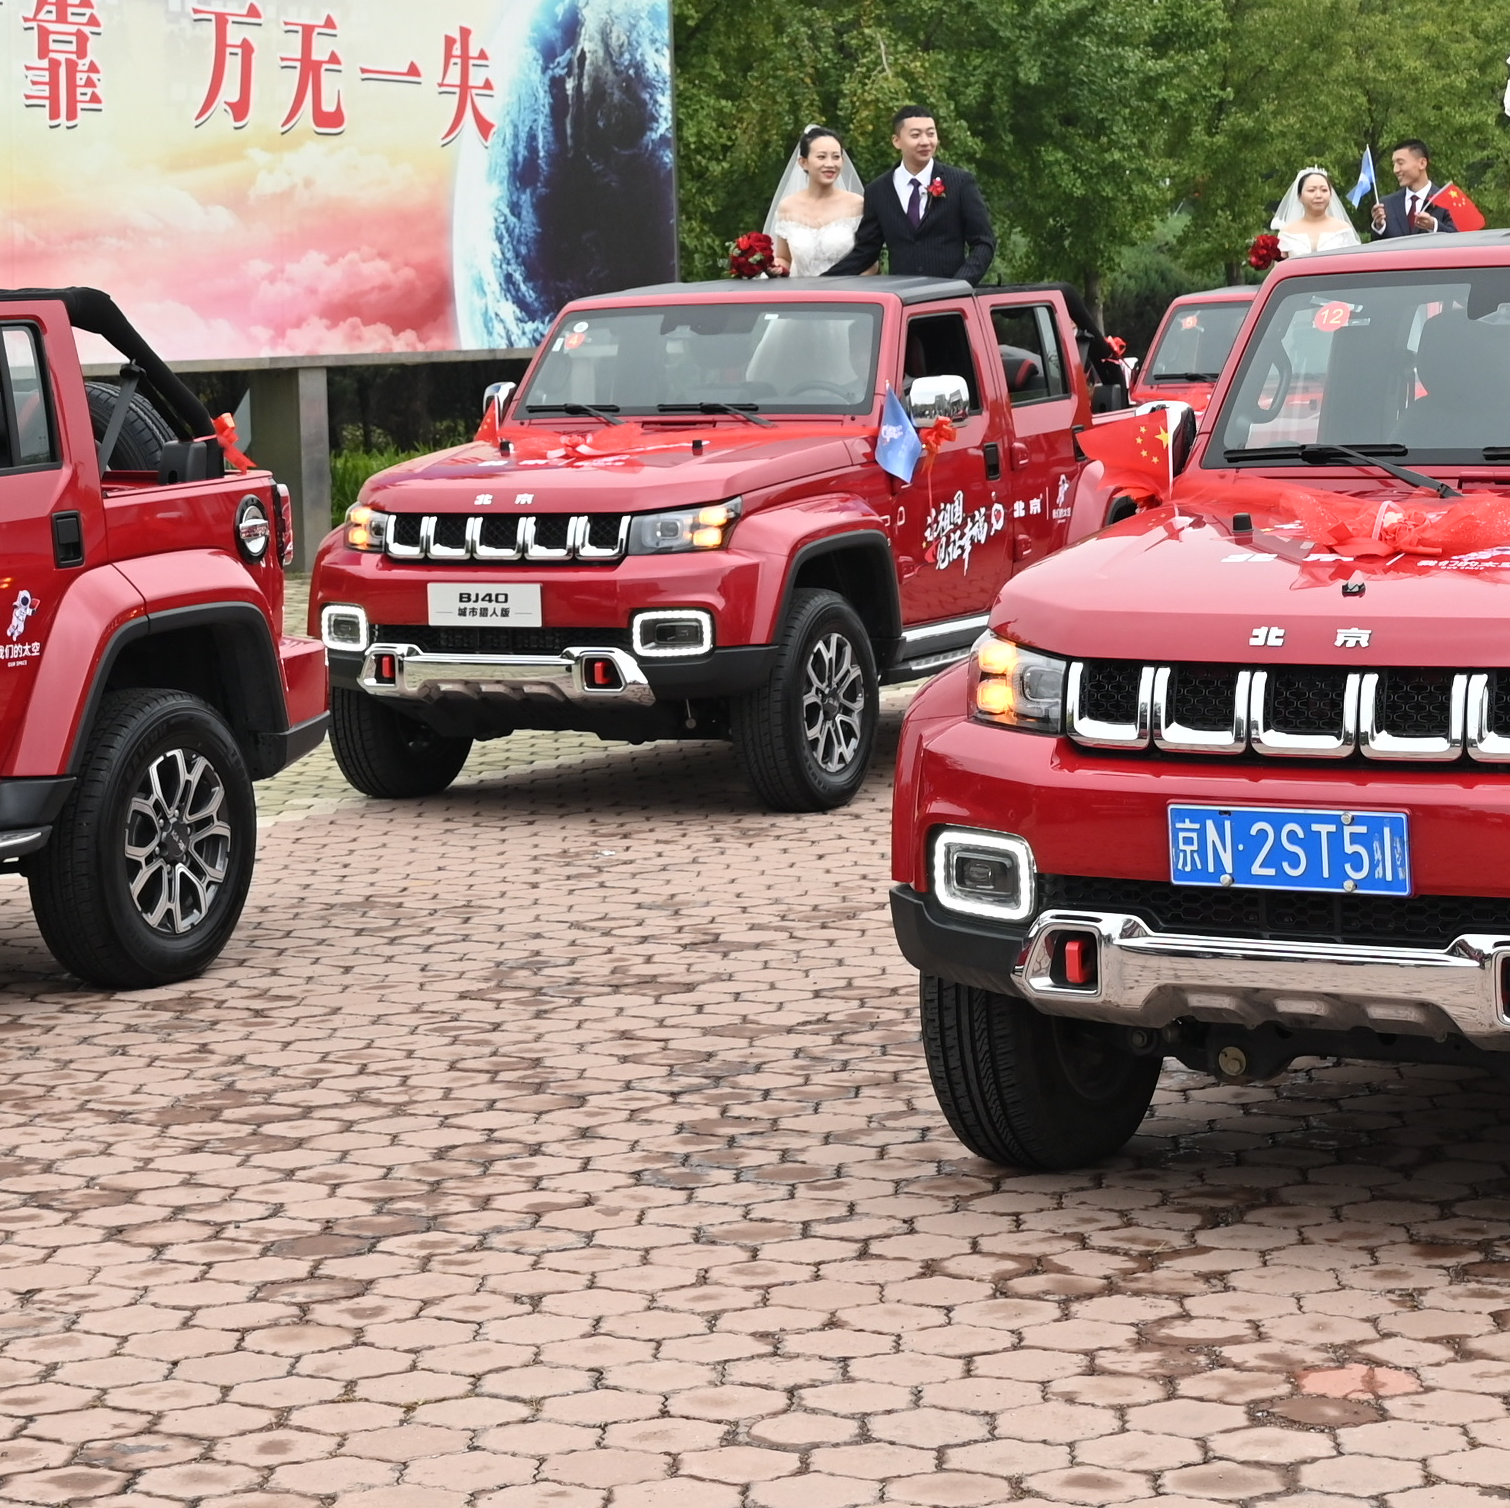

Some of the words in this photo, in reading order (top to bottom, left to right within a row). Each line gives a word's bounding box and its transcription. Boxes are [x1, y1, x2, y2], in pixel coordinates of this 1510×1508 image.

[191, 2, 497, 148] 万无一失
[1321, 308, 1344, 324] 12
[1013, 497, 1042, 518] 北京
[459, 593, 509, 603] BJ40
[457, 607, 510, 617] 城市猎人版
[1249, 626, 1372, 648] 北京
